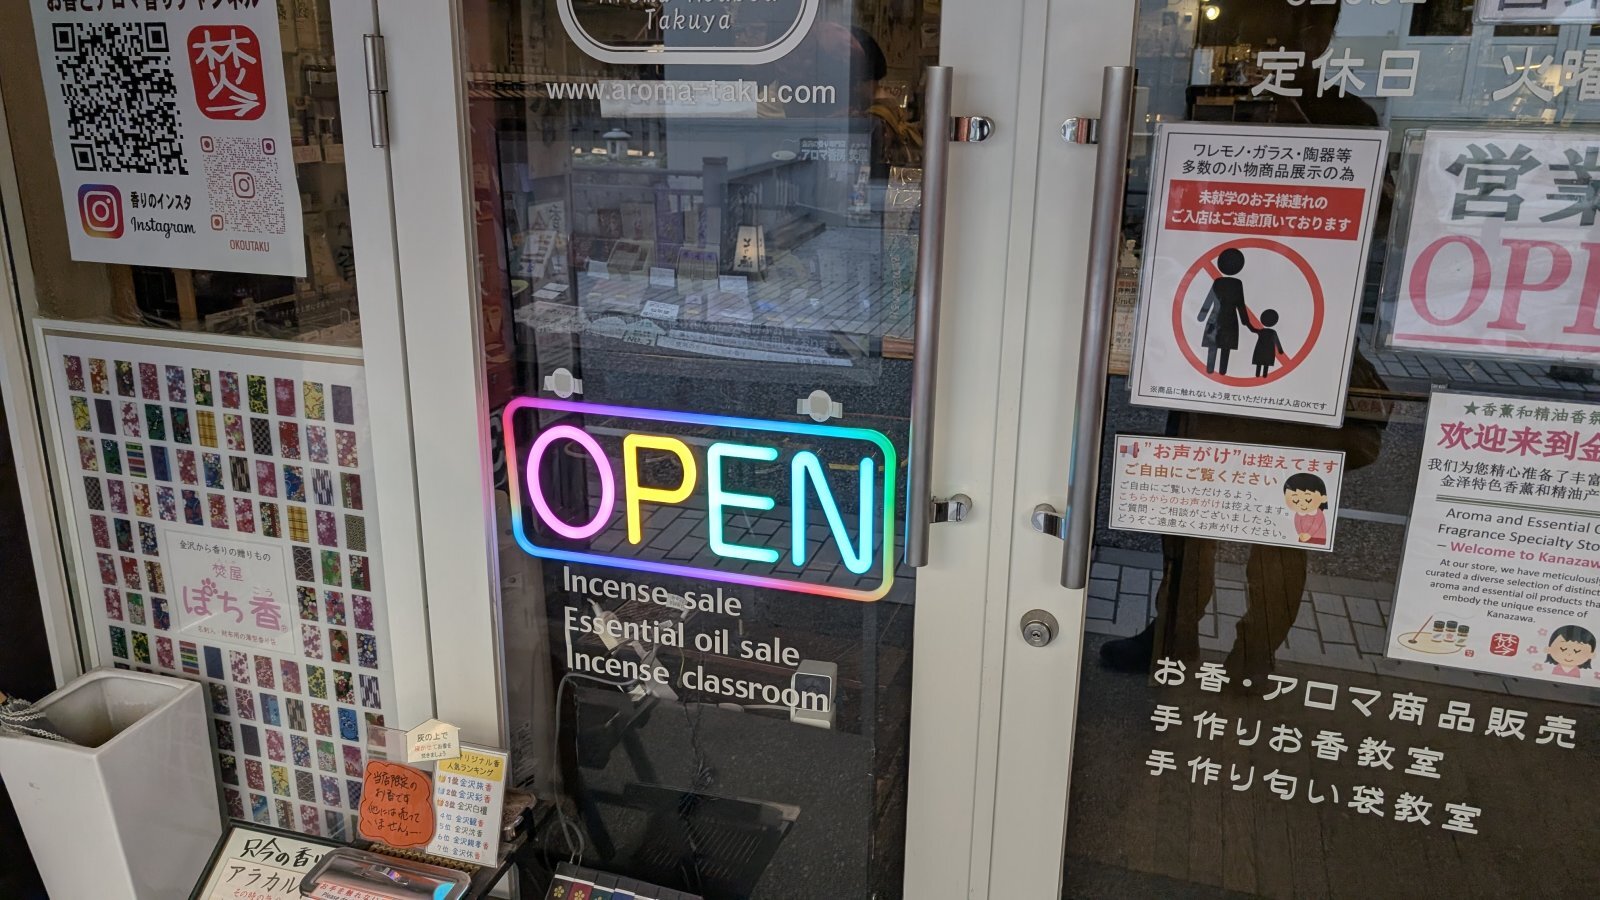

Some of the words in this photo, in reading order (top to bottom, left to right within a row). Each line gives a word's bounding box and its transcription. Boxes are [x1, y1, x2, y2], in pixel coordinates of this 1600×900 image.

[645, 8, 731, 32] Takuya
[1251, 46, 1420, 98] 定休日
[1493, 47, 1600, 101] 火曜
[545, 79, 836, 104] www.aroma-taku.com
[1193, 144, 1353, 164] ワレモノ・ガラス・陶器等
[1182, 160, 1355, 182] 多数の小物商品展示の為
[131, 192, 191, 211] 香りのインスタ
[1199, 190, 1328, 210] 未就学のお子様連れの
[131, 217, 196, 238] Instagram
[1171, 210, 1351, 232] ご入店はご遠慮頂いております
[229, 240, 270, 252] OKOUTAKU
[1437, 421, 1600, 463] 欢迎来到金
[1125, 463, 1278, 486] ご自由にご覧ください
[1428, 458, 1600, 487] 我们为您精心准备了丰富
[526, 425, 874, 574] OPEN
[1120, 481, 1258, 501] ご自由にご覧いただけるよう、
[1119, 492, 1290, 517] こちらからのお声がけは控えてます。
[1117, 514, 1287, 540] どうぞご遠慮なくお声がけください。
[1446, 508, 1492, 522] Aroma
[1496, 513, 1523, 526] and
[1527, 517, 1591, 534] Essential
[1438, 523, 1506, 541] Fragrance
[1509, 532, 1574, 550] Specialty
[1576, 539, 1600, 552] Sto
[1440, 558, 1451, 567] At
[1452, 561, 1469, 569] our
[1471, 563, 1498, 573] store,
[1501, 567, 1515, 575] we
[1517, 567, 1540, 577] have
[1450, 541, 1516, 559] Welcome
[1520, 550, 1535, 561] to
[1538, 552, 1600, 569] Kanazaw
[563, 566, 669, 605] Incense
[684, 587, 742, 617] sale
[1426, 569, 1461, 580] curated
[1471, 573, 1505, 585] diverse
[1507, 577, 1550, 590] selection
[1552, 583, 1564, 592] of
[1565, 585, 1600, 597] distinct
[1430, 581, 1460, 591] aroma
[1462, 584, 1480, 593] and
[1482, 586, 1523, 599] essential
[1525, 592, 1538, 600] oil
[1539, 594, 1583, 607] products
[182, 578, 281, 631] ぽち香
[1442, 593, 1481, 606] embody
[1483, 598, 1499, 607] the
[1501, 601, 1534, 613] unique
[1536, 606, 1575, 617] essence
[1577, 610, 1589, 619] of
[1487, 610, 1536, 623] Kanazawa.
[563, 607, 684, 648] Essential
[694, 628, 729, 656] oil
[741, 637, 800, 666] sale
[567, 644, 670, 685] Incense
[682, 665, 829, 712] classroom
[1153, 656, 1577, 749] お香・アロマ商品販売
[1150, 704, 1445, 780] 手作りお香教室
[373, 771, 417, 792] 当店限定の
[447, 763, 494, 777] 人気ランキング
[1145, 749, 1482, 835] 手作り匂い袋教室
